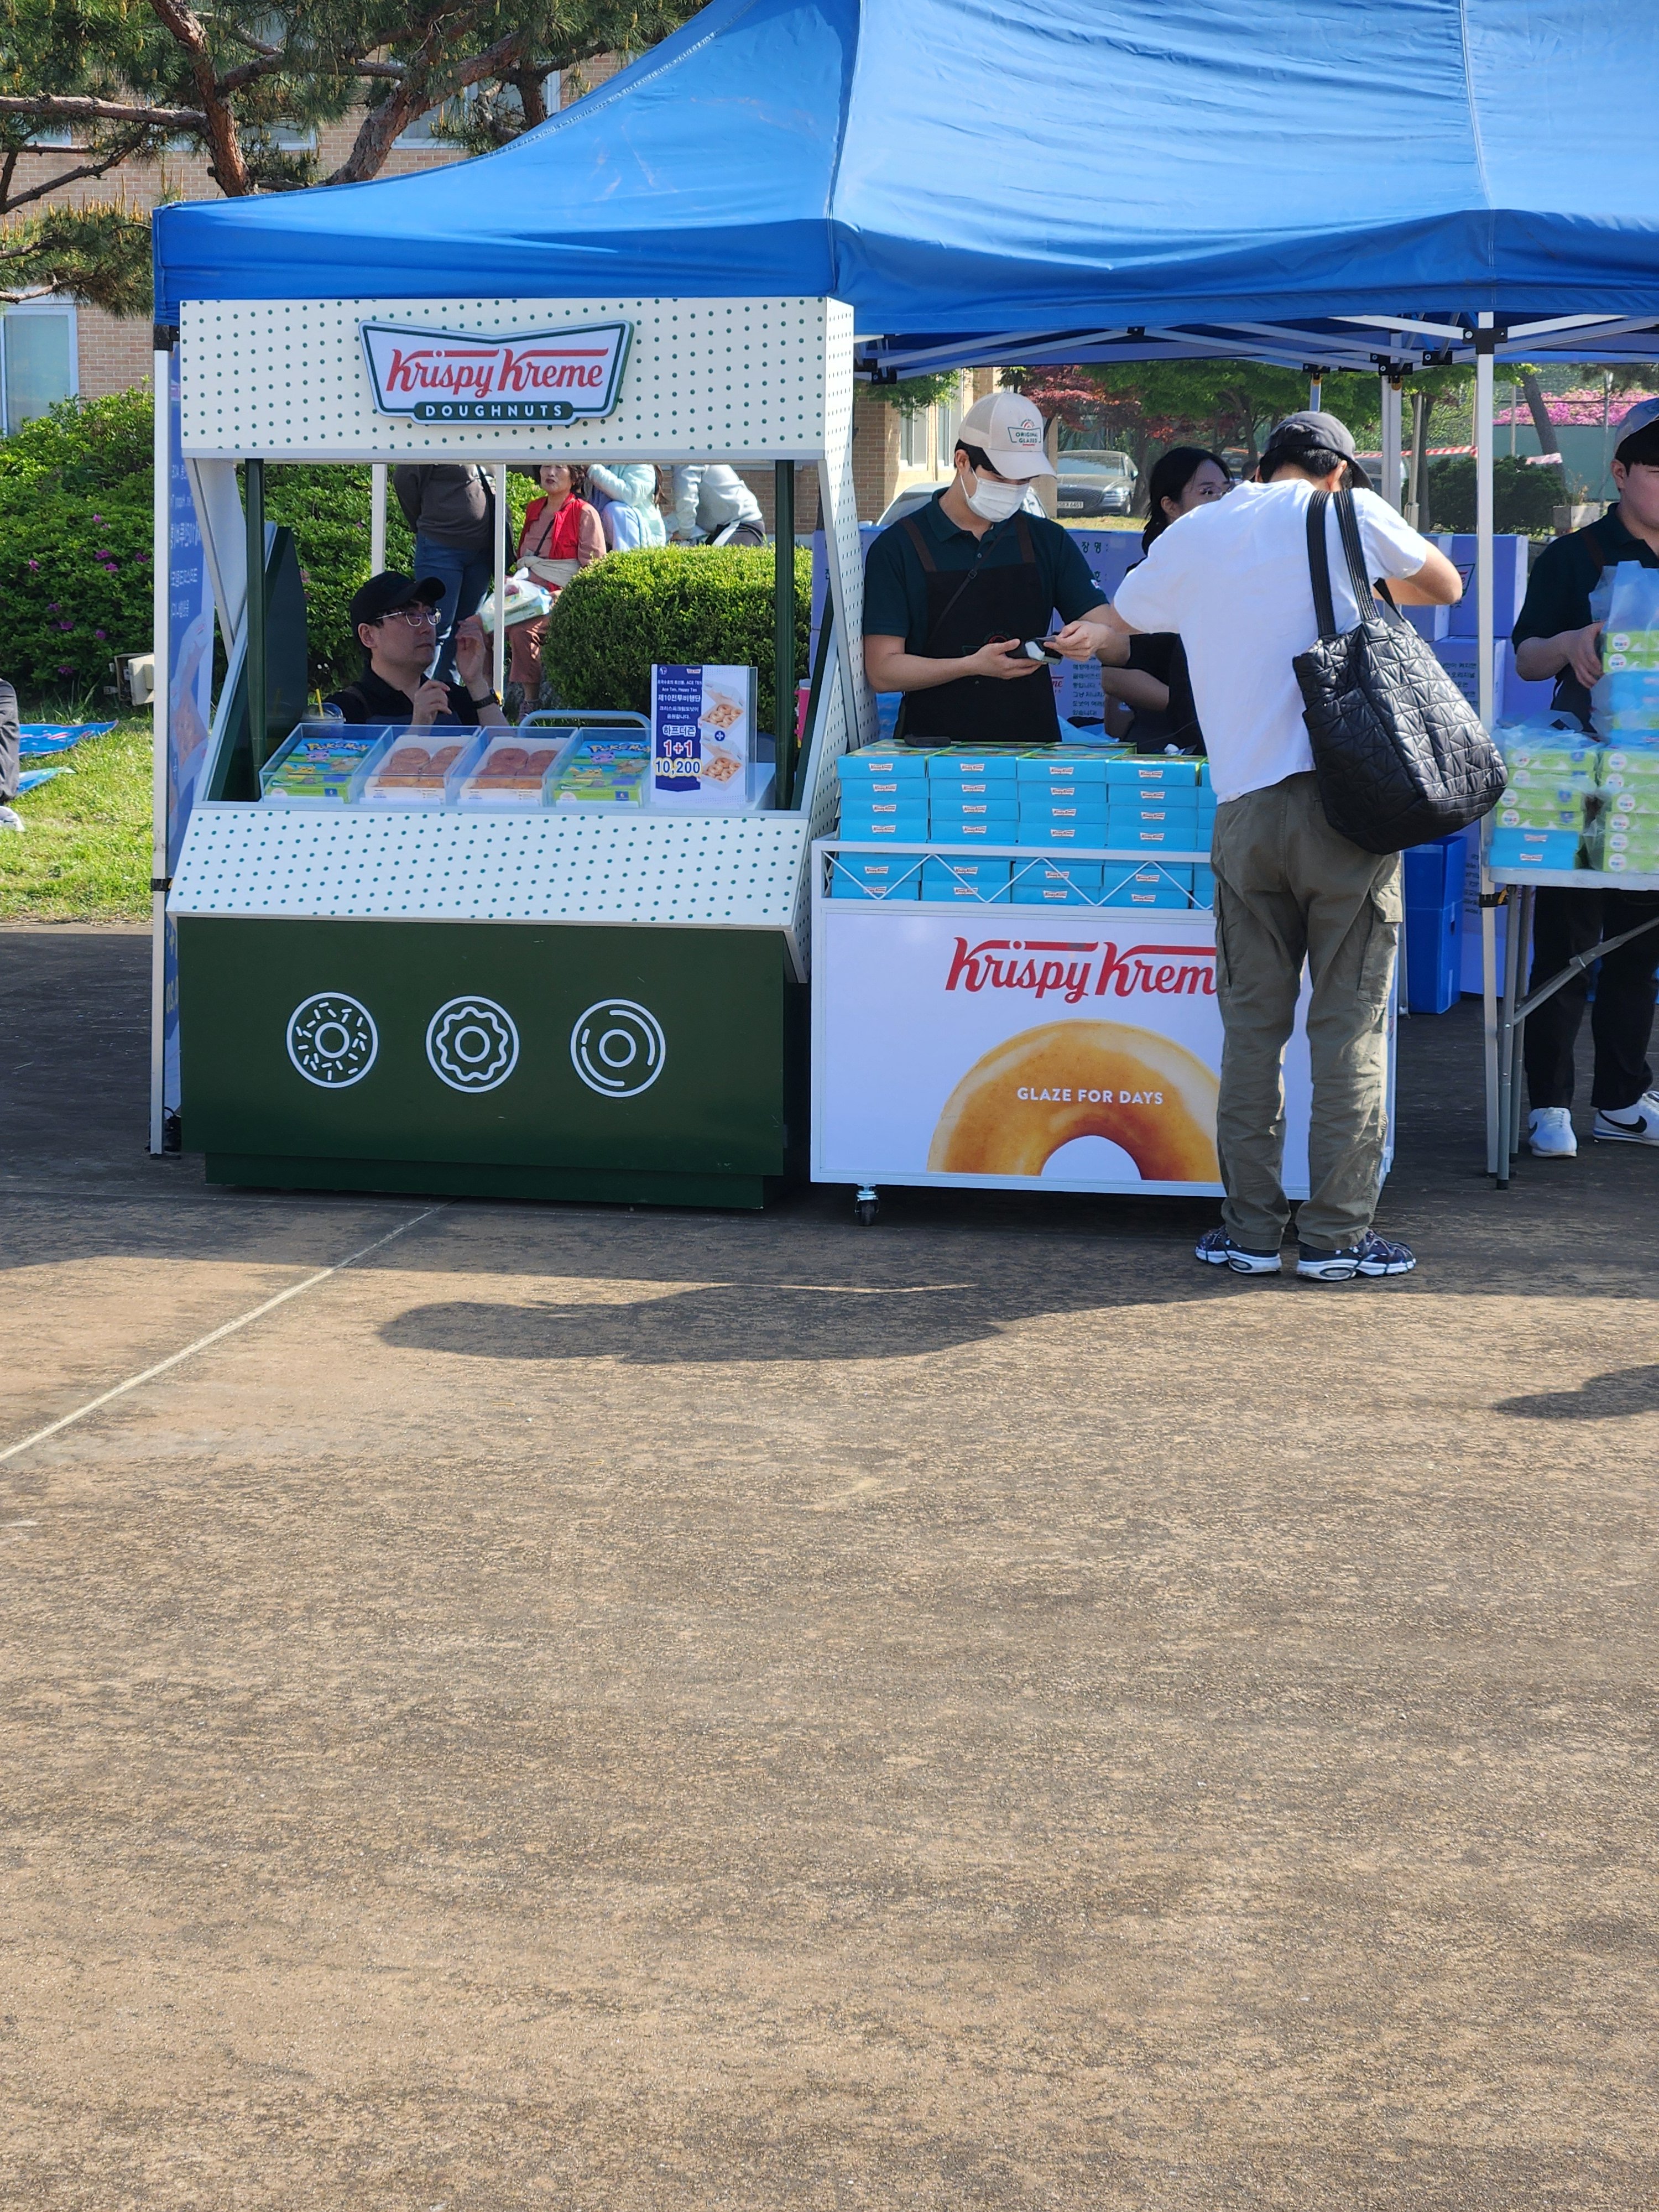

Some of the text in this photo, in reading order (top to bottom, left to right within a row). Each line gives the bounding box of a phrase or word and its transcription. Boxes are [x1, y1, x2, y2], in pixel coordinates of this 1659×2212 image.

[386, 349, 608, 398] Krispy Kreme
[425, 404, 562, 418] DOUGHNUTS
[663, 726, 696, 736] 하프더즌
[664, 740, 693, 757] 1+1
[655, 759, 701, 775] 10,200
[945, 937, 1217, 1004] Krispy Krem
[1017, 1087, 1163, 1105] GLAZE FOR DAYS
